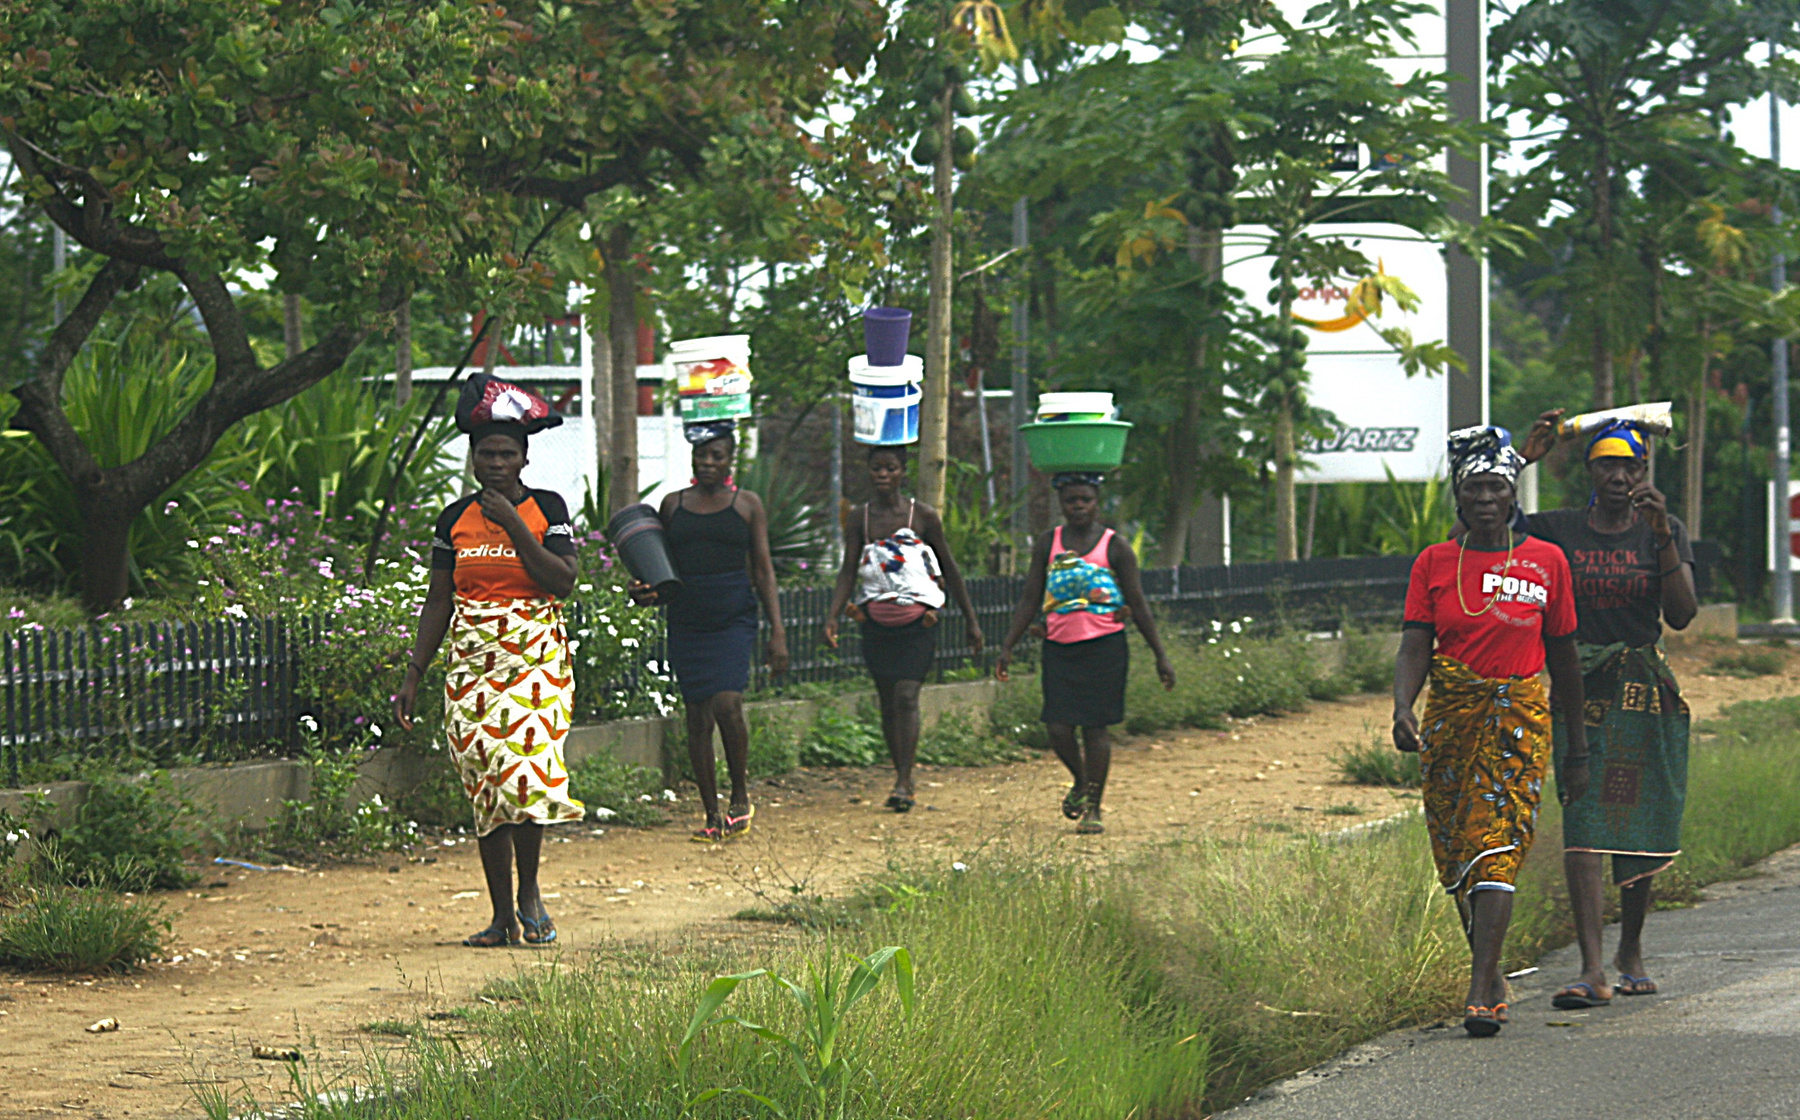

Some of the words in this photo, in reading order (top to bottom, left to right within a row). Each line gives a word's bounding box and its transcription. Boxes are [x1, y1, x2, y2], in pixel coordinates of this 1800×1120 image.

[458, 544, 517, 558] adida
[1573, 549, 1639, 565] STUCK
[1585, 564, 1599, 574] IN
[1604, 565, 1627, 575] THE
[1482, 572, 1547, 603] POLIC
[1495, 593, 1513, 602] THE
